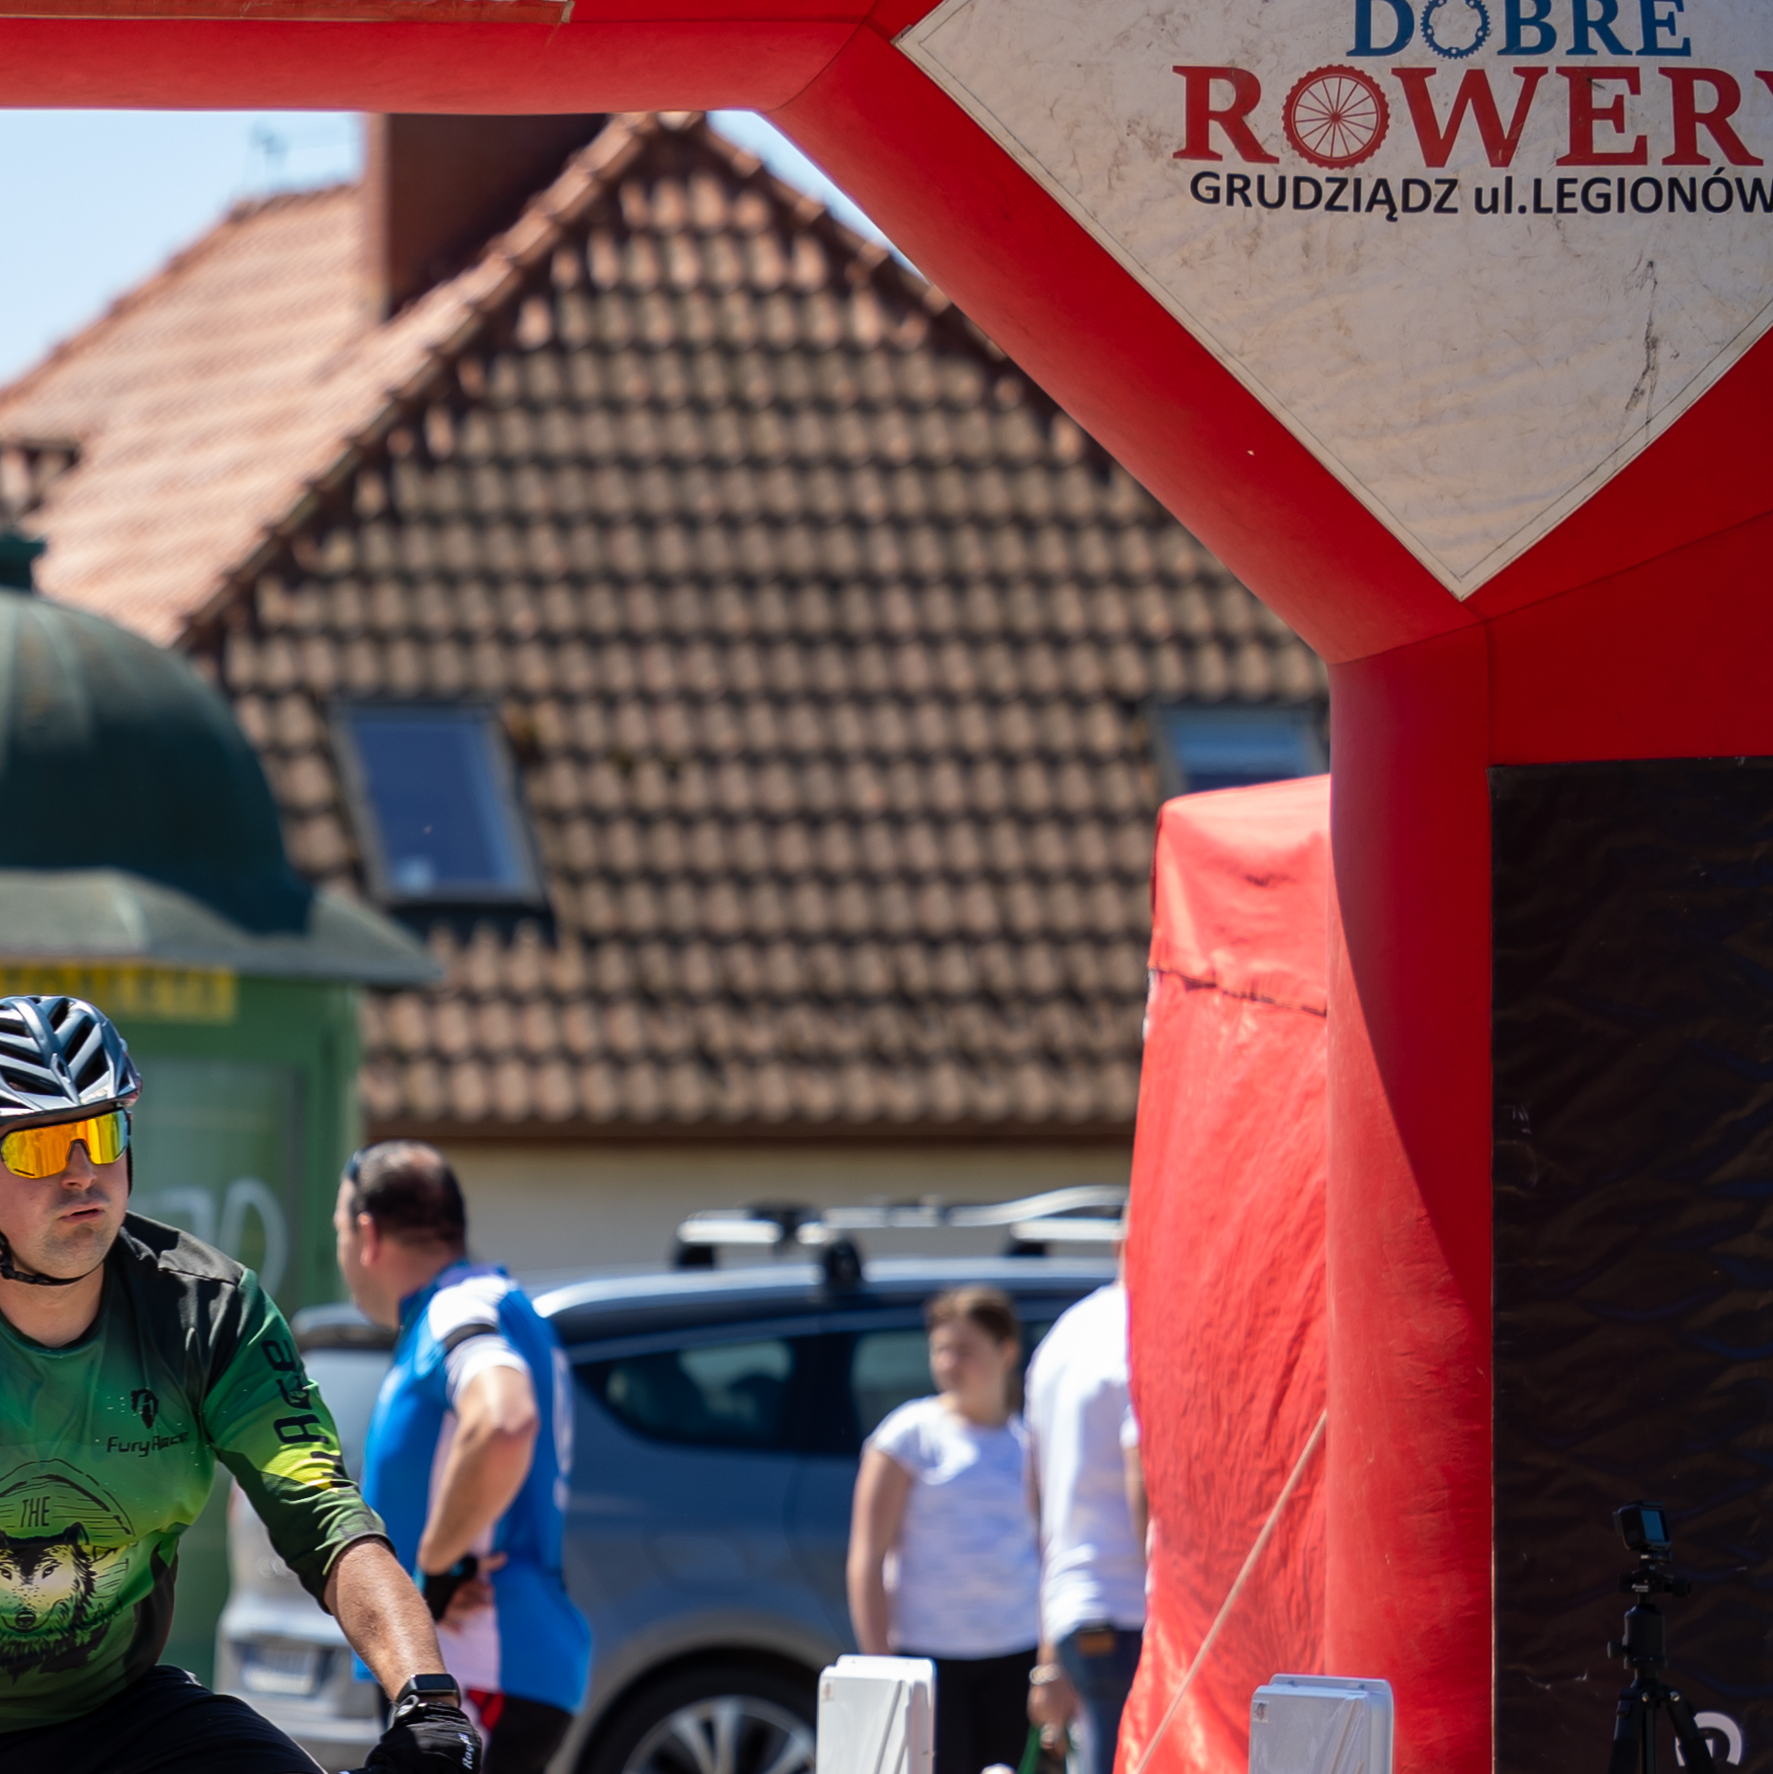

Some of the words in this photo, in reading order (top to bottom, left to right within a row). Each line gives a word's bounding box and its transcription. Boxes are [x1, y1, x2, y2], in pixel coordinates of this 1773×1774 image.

[1345, 0, 1692, 60] DOBRE
[1171, 63, 1773, 170] ROWER
[1189, 170, 1460, 223] GRUDZIĄDZ
[20, 1496, 52, 1528] THE
